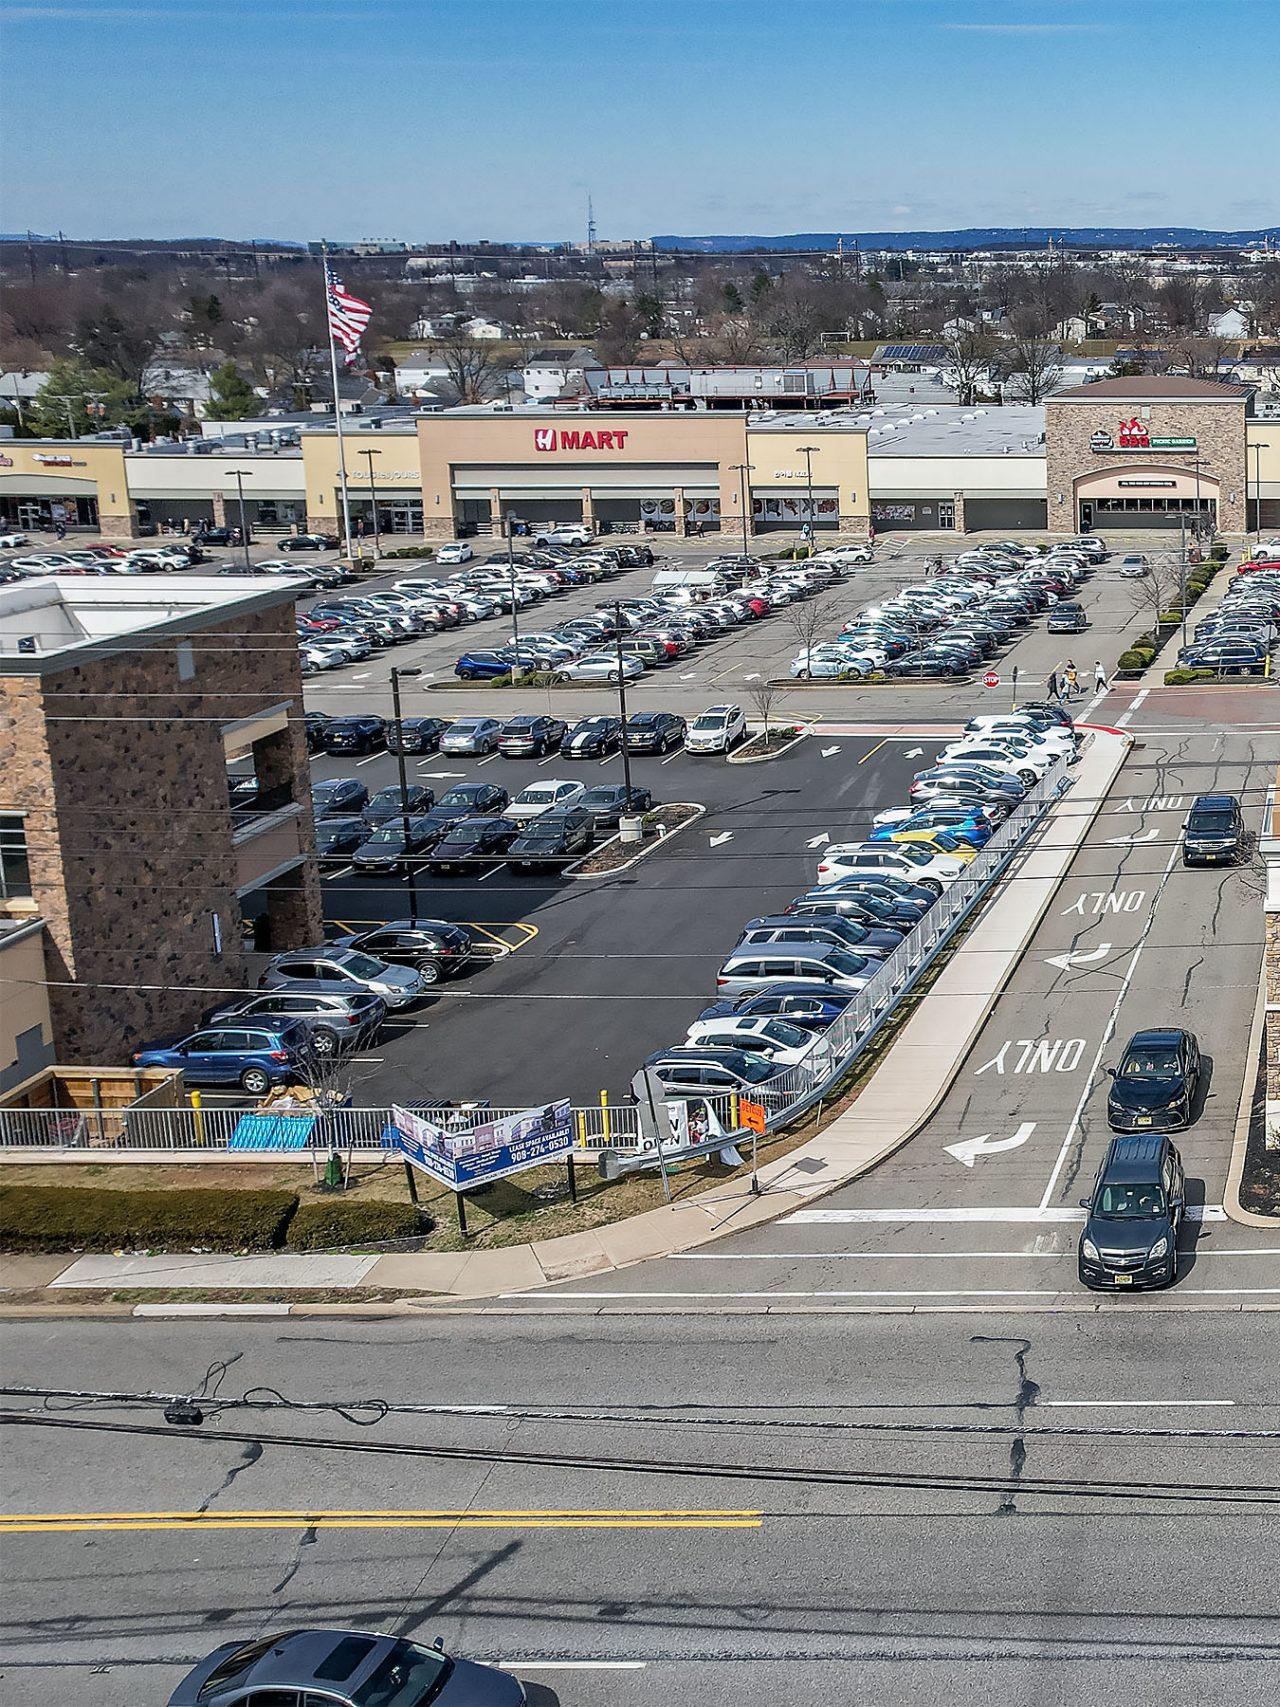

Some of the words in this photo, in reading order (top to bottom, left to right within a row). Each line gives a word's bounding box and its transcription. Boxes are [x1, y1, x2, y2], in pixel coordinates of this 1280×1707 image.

[535, 429, 557, 451] H
[561, 430, 628, 449] MART
[1114, 794, 1184, 812] ONLY
[1061, 890, 1146, 916] ONLY
[974, 1038, 1087, 1076] ONLY
[511, 1136, 569, 1163] 908-274-0530
